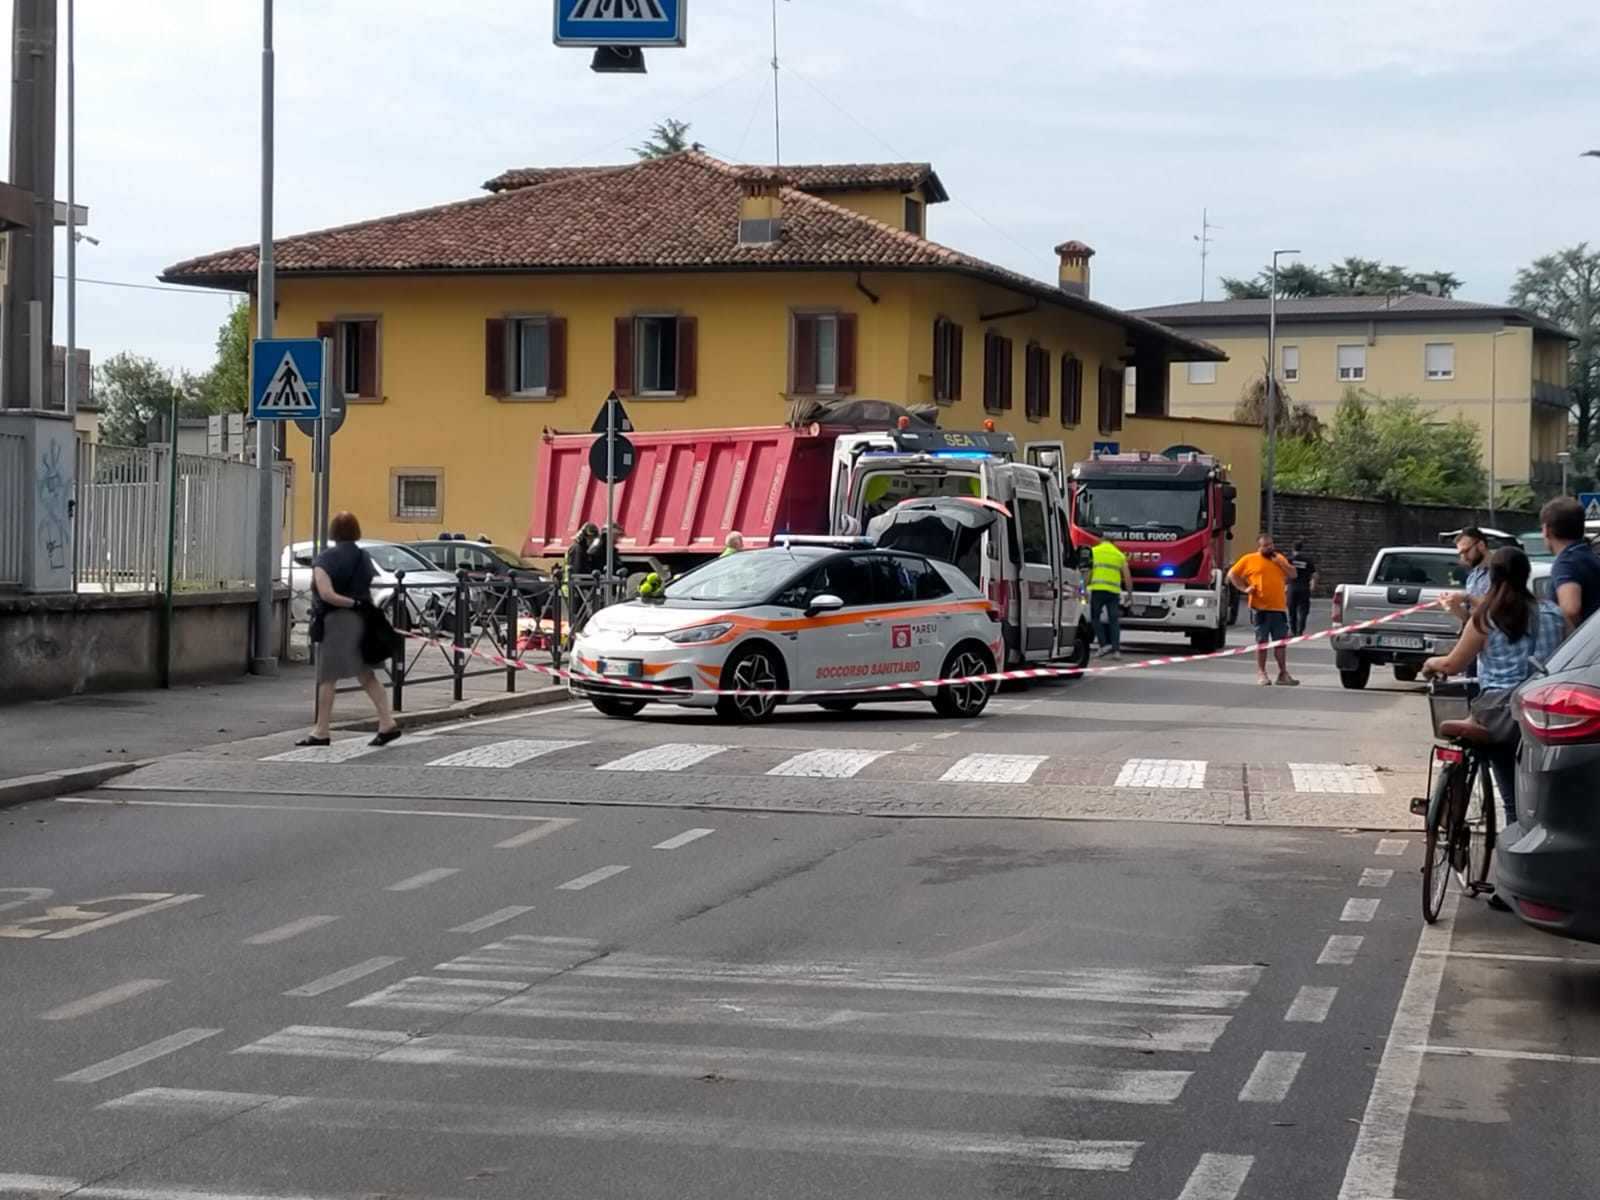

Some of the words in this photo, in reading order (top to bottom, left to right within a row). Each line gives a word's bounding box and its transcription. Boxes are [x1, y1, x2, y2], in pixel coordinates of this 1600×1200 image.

[943, 433, 976, 447] SEA
[1128, 532, 1145, 540] DEL
[1147, 532, 1178, 541] FUOCO
[1124, 552, 1161, 562] VECO
[915, 624, 937, 634] AREU
[816, 664, 869, 679] SOCCORSO
[871, 661, 920, 675] SANITARIO
